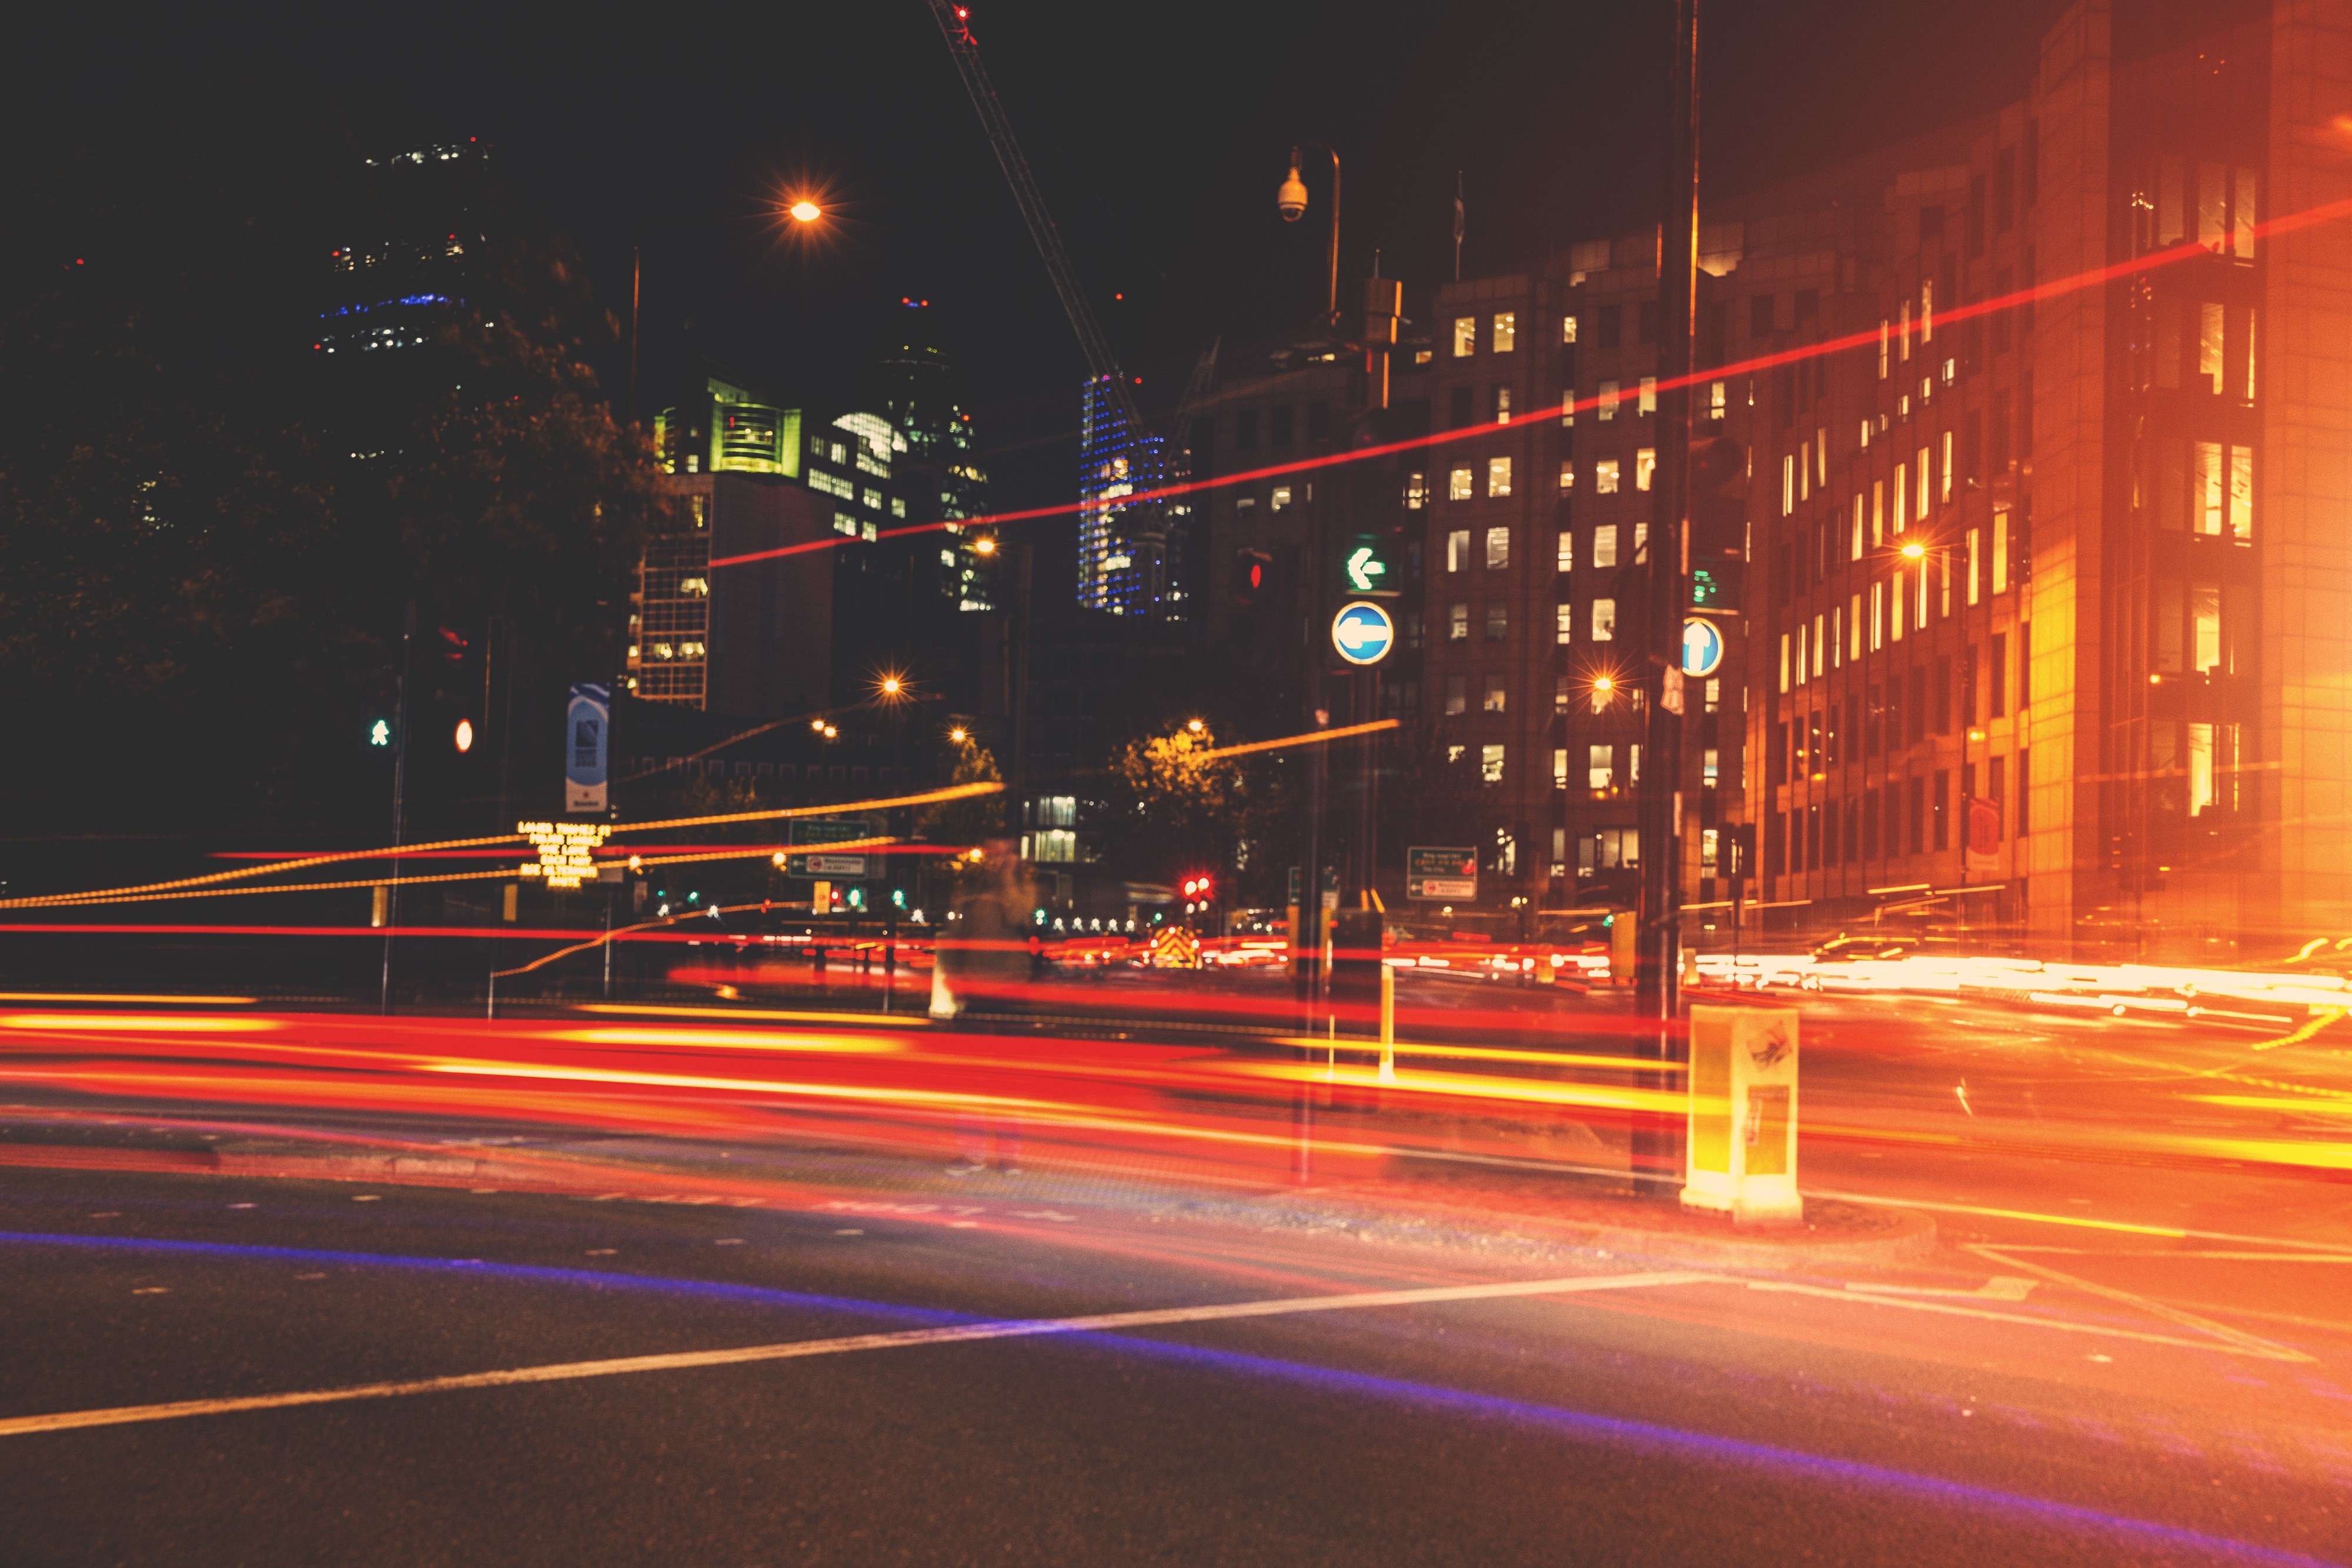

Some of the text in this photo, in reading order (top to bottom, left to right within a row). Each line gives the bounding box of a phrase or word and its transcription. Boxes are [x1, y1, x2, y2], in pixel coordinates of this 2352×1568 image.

[518, 821, 553, 834] LOWER
[556, 823, 596, 835] THAMES
[562, 844, 589, 856] LANE
